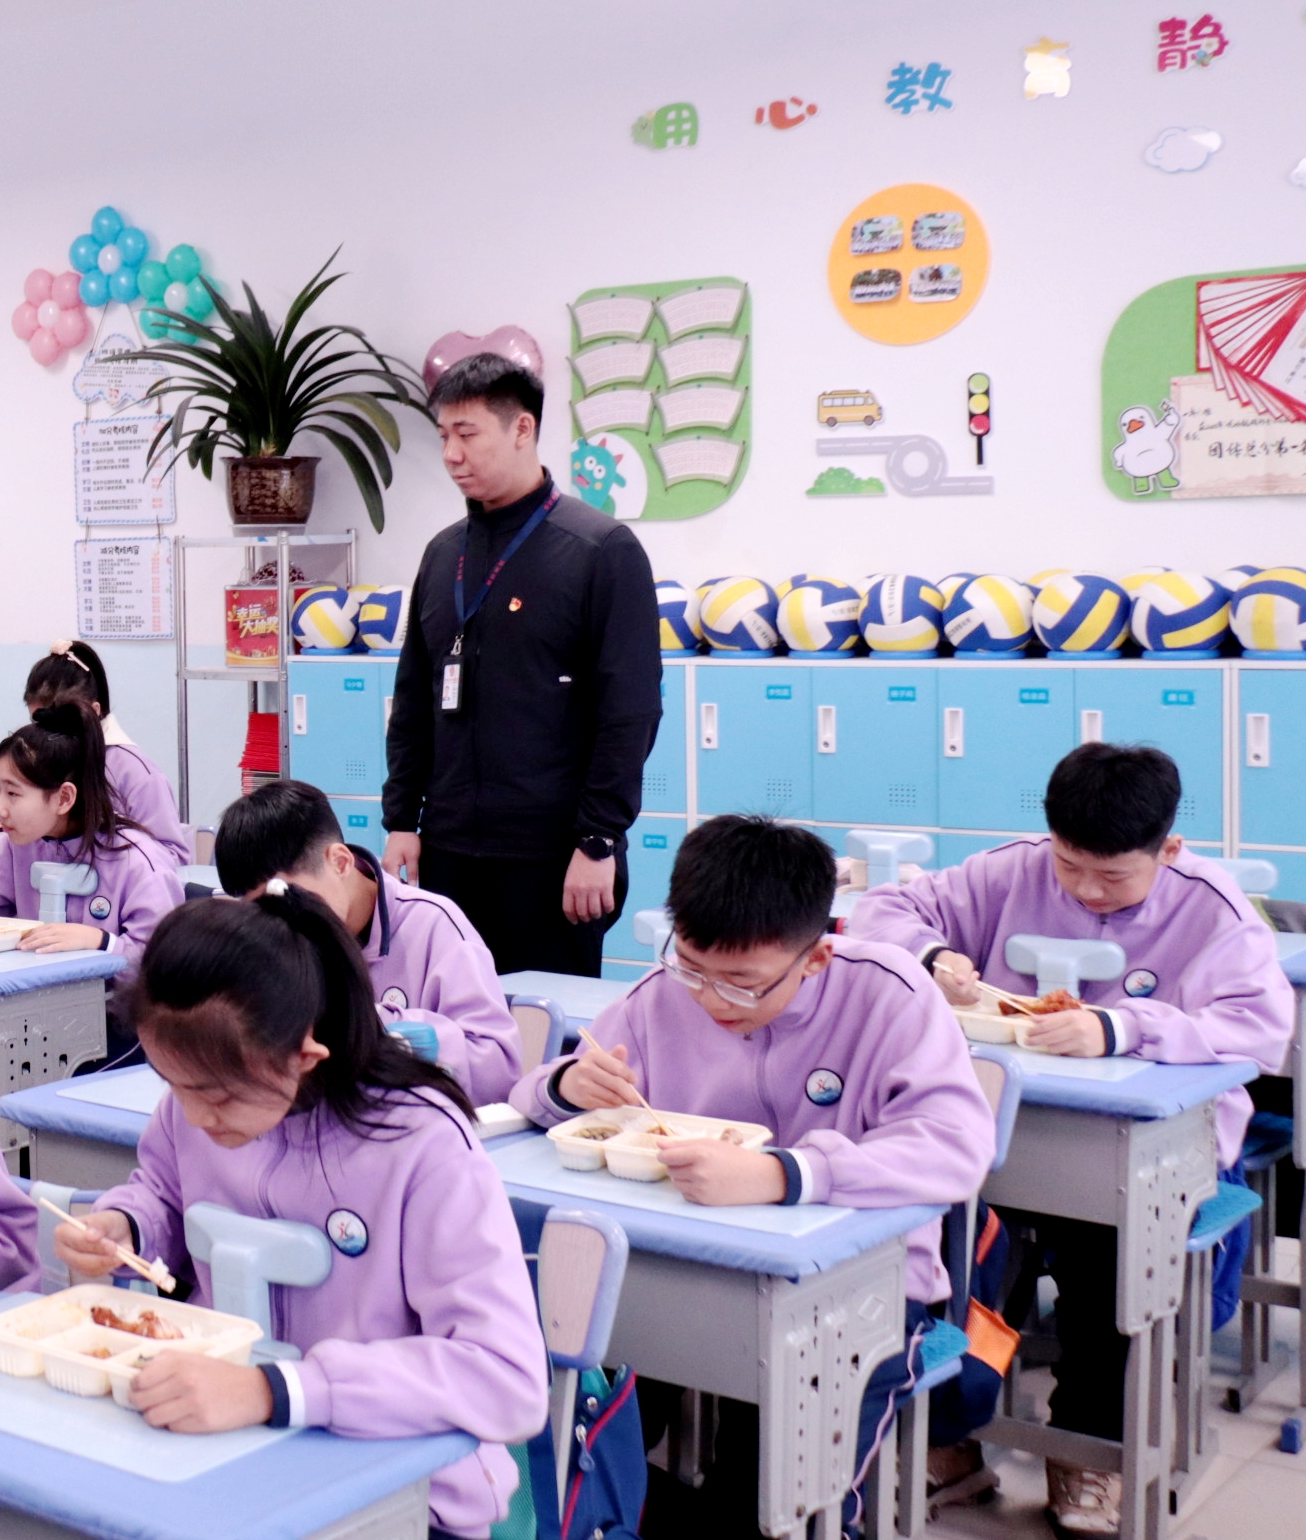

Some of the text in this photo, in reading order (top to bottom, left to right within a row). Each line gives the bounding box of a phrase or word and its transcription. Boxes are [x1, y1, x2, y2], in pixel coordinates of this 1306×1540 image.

[653, 102, 699, 148] 用
[753, 97, 818, 130] 心
[885, 62, 952, 115] 教
[1157, 13, 1230, 73] 静
[240, 616, 278, 639] 大抽奖
